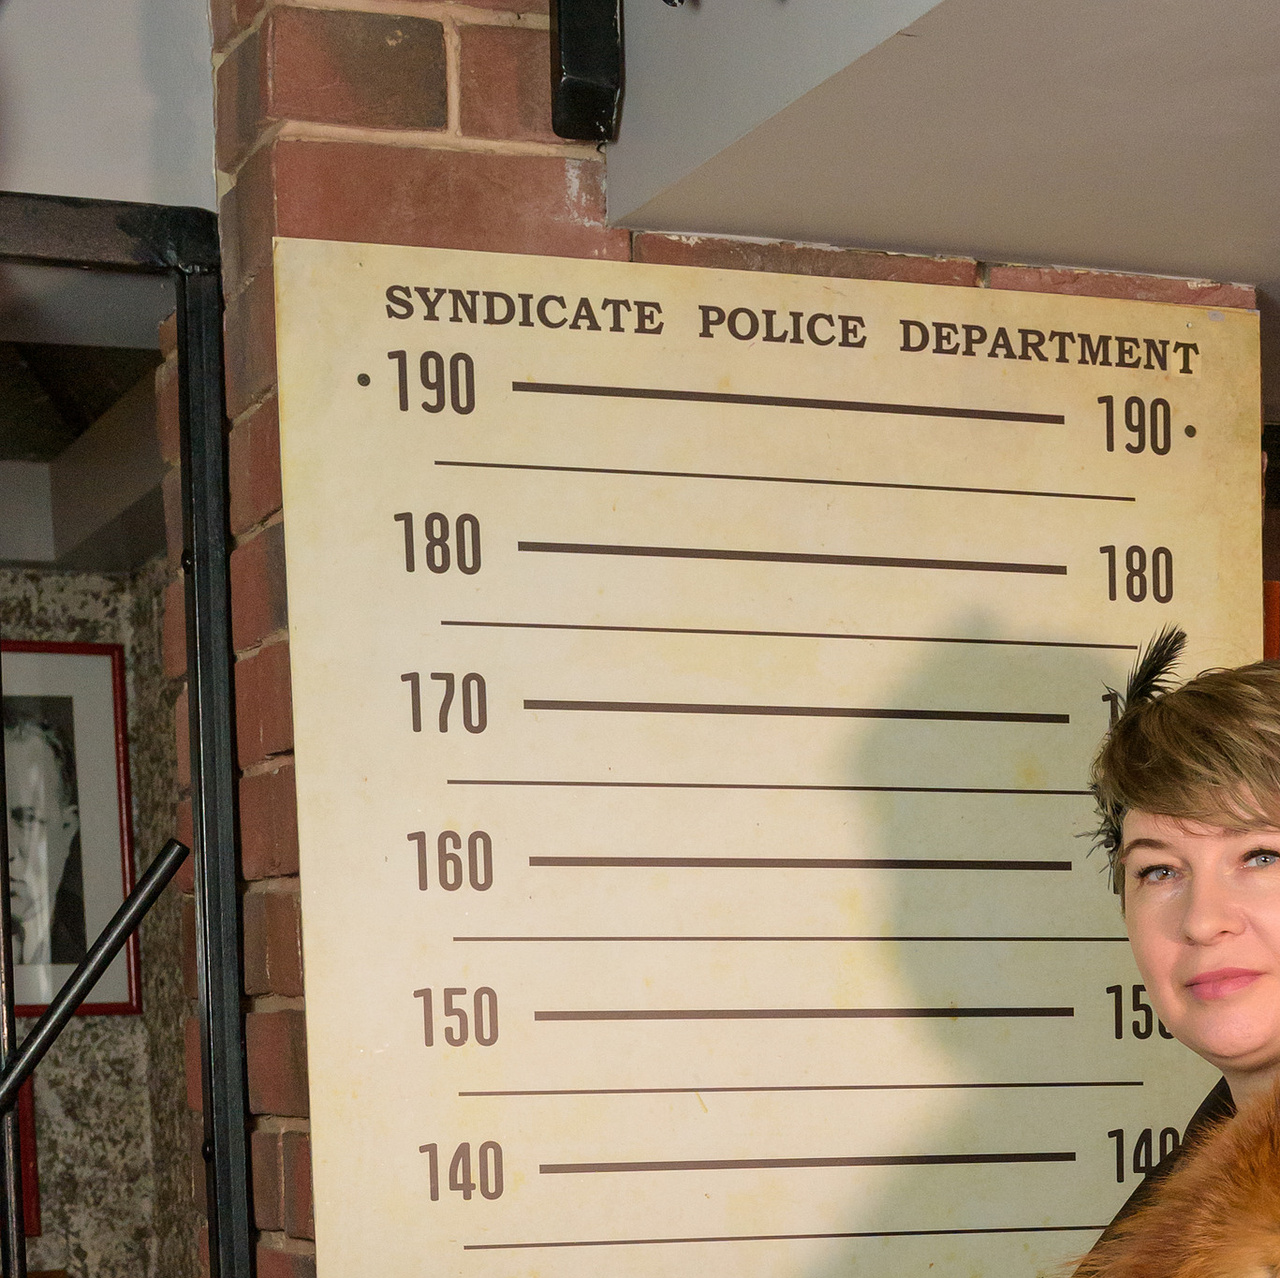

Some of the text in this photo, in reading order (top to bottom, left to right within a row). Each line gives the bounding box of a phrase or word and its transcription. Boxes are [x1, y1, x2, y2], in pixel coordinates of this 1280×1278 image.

[385, 284, 1200, 375] SYNDICATE POLICE DEPARTMENT
[387, 349, 476, 416] 190
[1097, 394, 1172, 456] 190
[393, 511, 482, 576] 180
[1099, 544, 1174, 604] 180
[400, 671, 488, 735] 170
[406, 830, 494, 892] 160
[412, 986, 499, 1048] 150
[418, 1140, 504, 1202] 140
